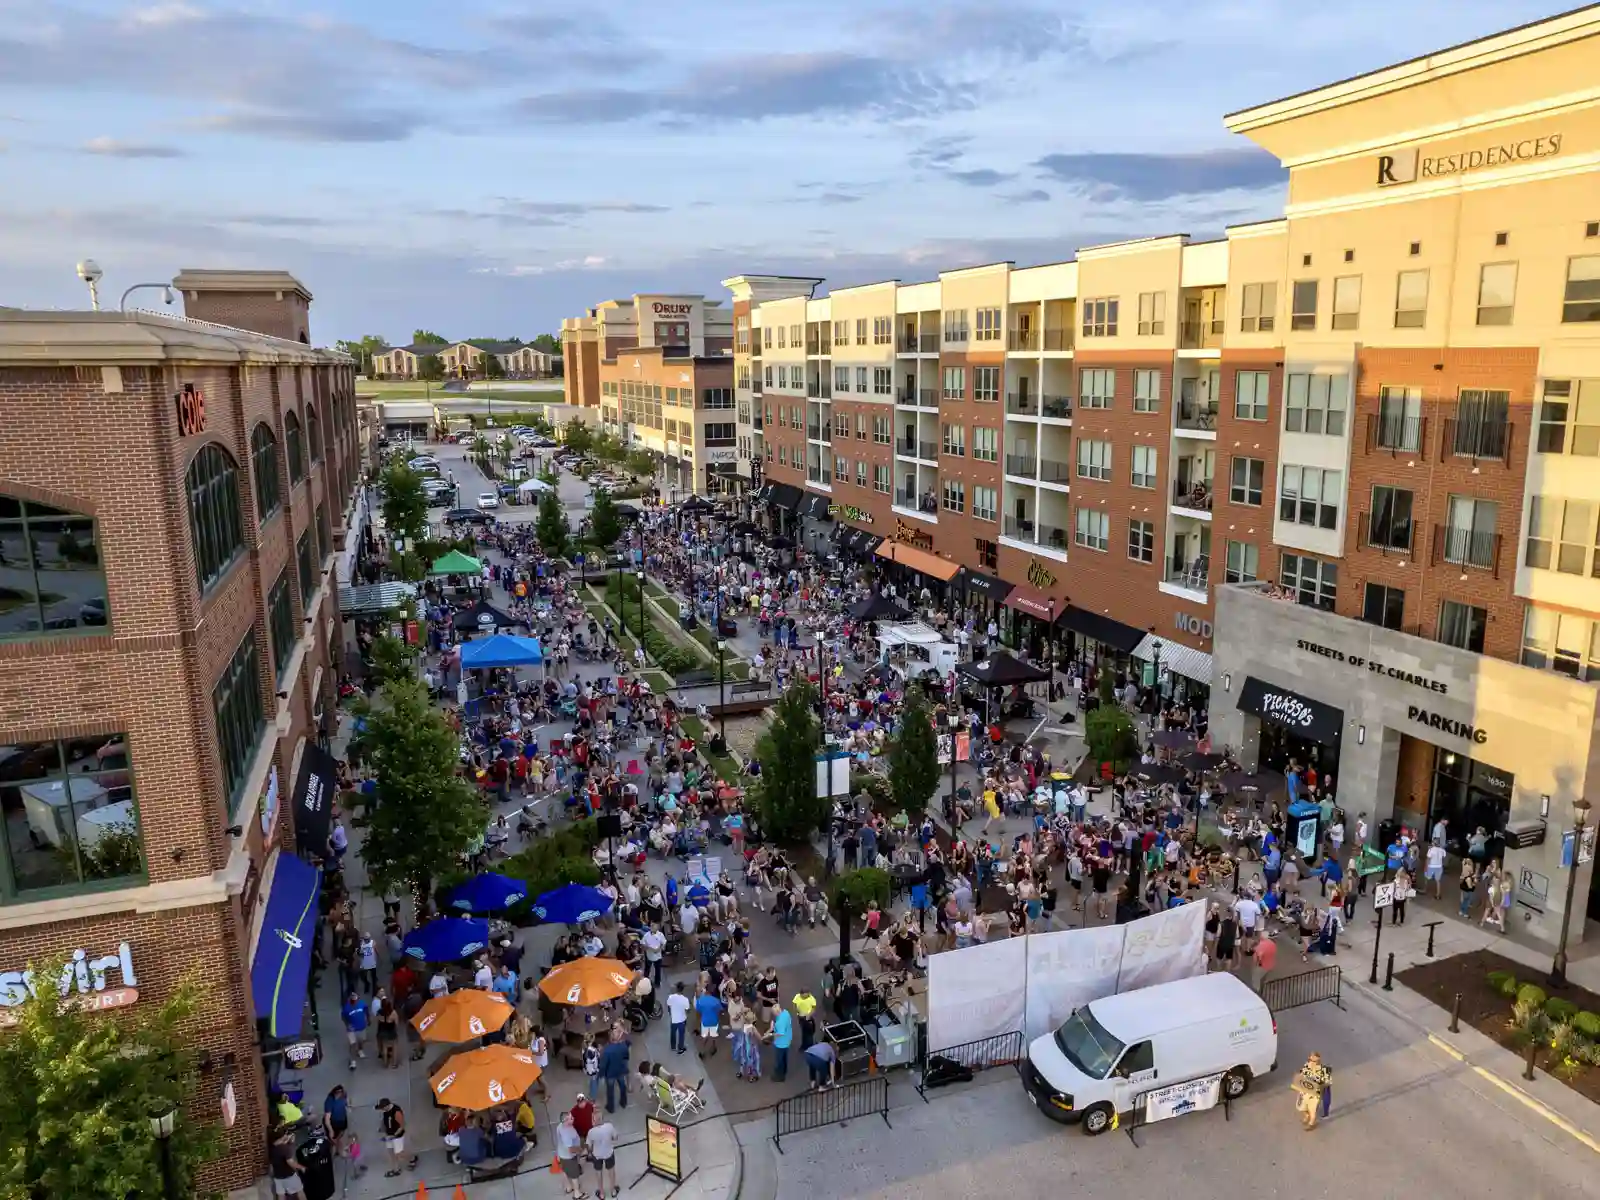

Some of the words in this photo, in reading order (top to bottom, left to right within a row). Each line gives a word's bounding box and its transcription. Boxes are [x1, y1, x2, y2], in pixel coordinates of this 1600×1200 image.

[1376, 155, 1398, 185] R
[1422, 133, 1562, 177] RESIDENCES
[652, 302, 692, 314] DRURY
[1174, 611, 1213, 638] MOD
[1296, 639, 1345, 661] STREETS
[1348, 655, 1365, 667] OF
[1368, 661, 1386, 675] ST.
[1387, 667, 1448, 694] CHARLES
[1263, 693, 1314, 726] PICASSO'S
[1271, 712, 1296, 726] coffee
[1407, 704, 1487, 744] PARKING
[1149, 1087, 1176, 1099] STREET
